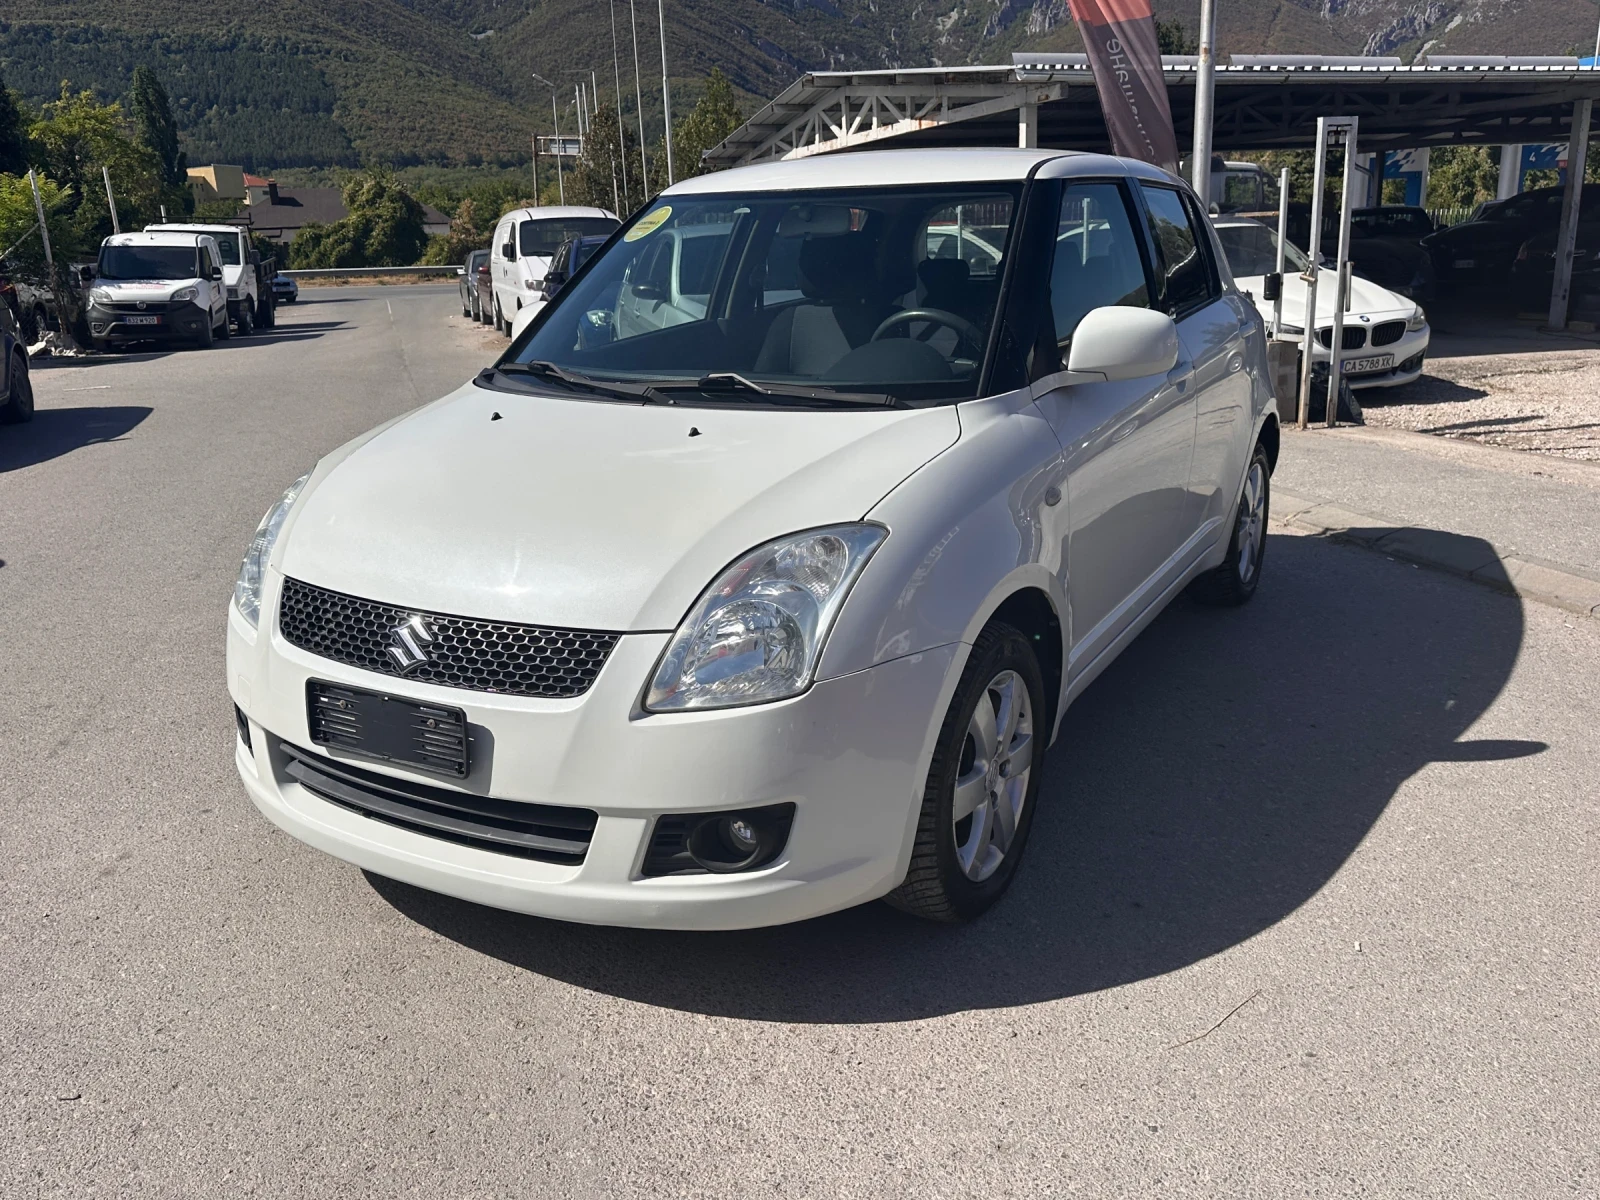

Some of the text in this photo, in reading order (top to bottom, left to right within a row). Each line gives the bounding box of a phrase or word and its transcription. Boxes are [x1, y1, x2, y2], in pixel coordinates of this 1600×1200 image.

[1529, 151, 1536, 162] 4
[1344, 357, 1391, 372] CA 5788 XK
